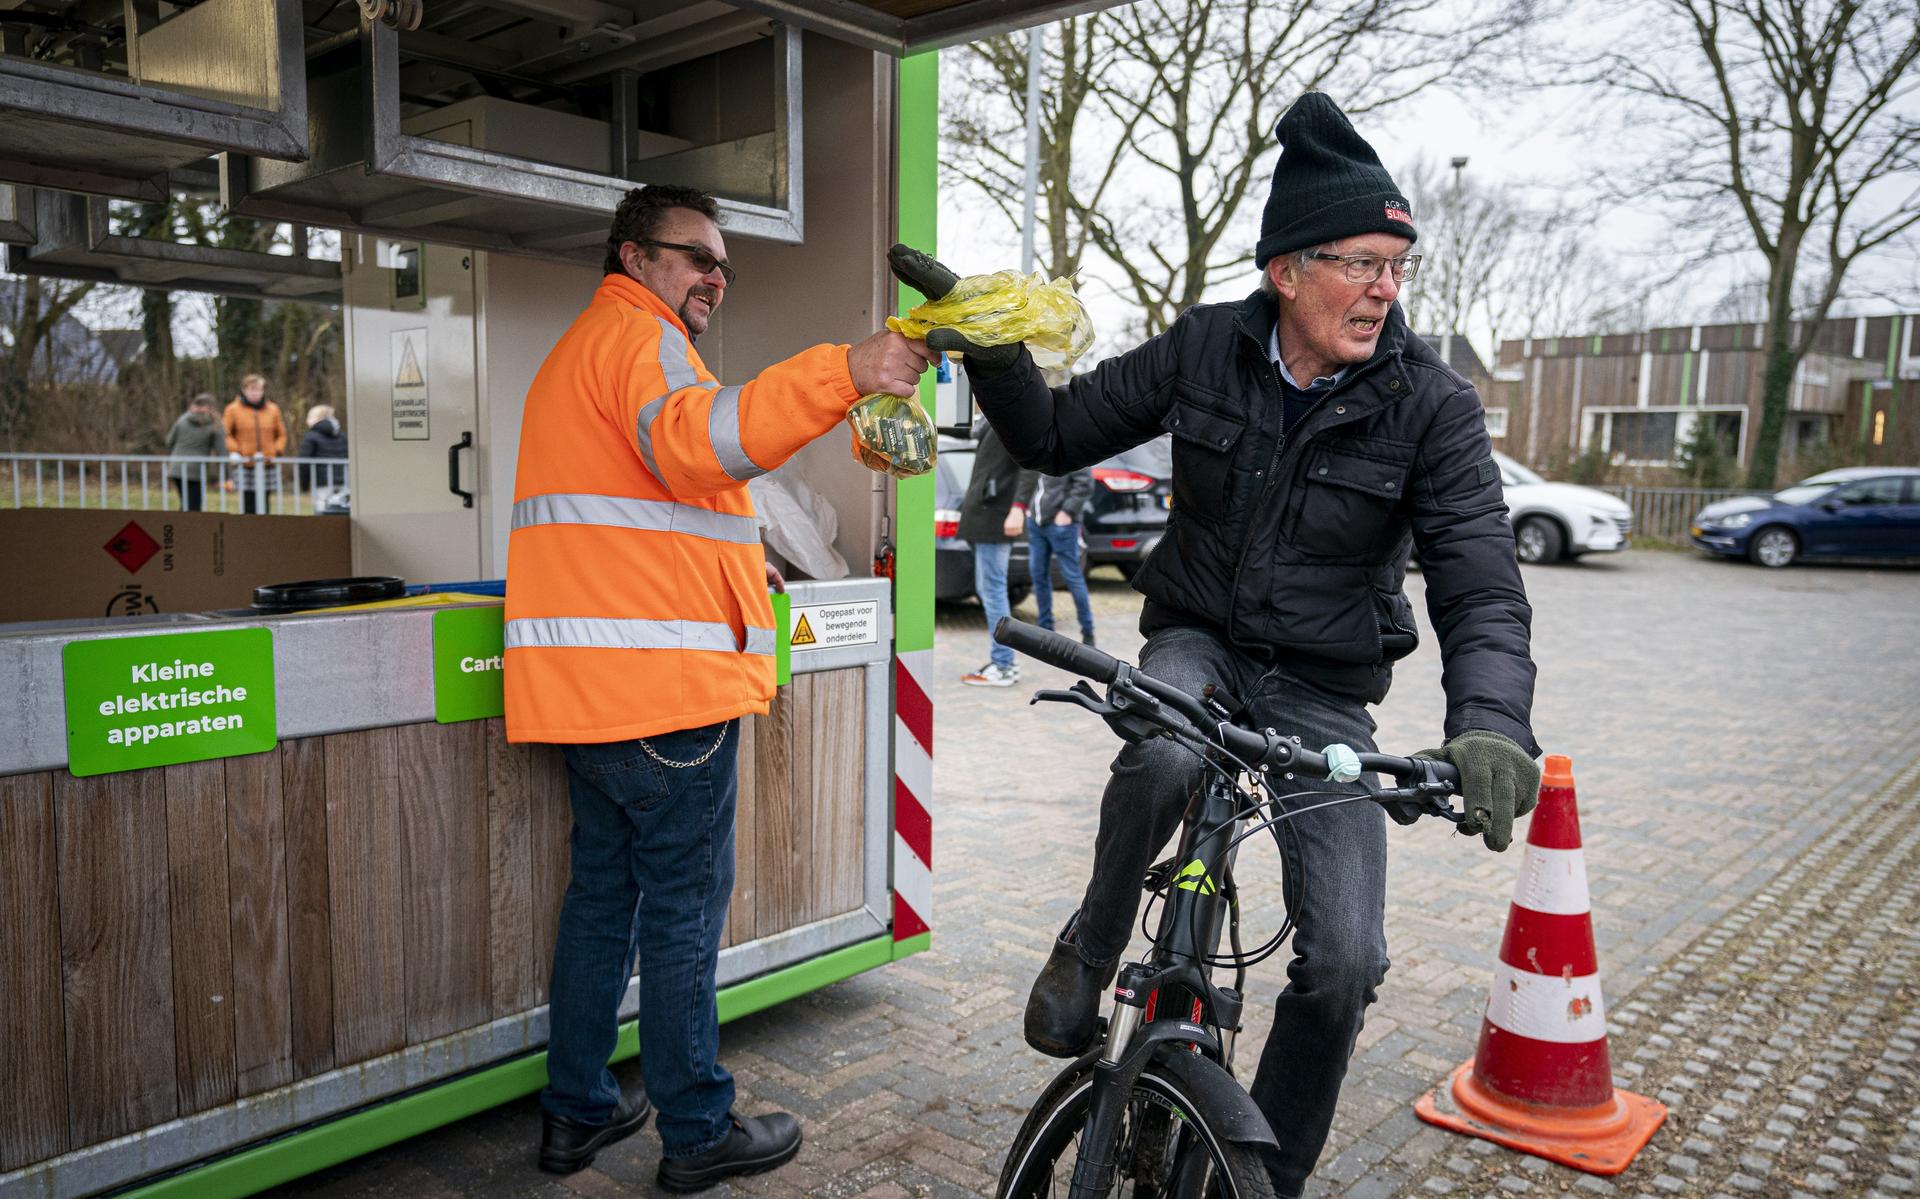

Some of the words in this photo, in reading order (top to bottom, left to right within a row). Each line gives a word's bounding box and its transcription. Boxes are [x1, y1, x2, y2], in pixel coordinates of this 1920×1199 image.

[163, 524, 174, 550] 1950
[163, 554, 174, 571] UN
[820, 608, 855, 619] Opgepast
[826, 620, 867, 630] bewegende
[826, 633, 867, 643] onderdelen
[131, 659, 215, 684] Kleine
[99, 684, 248, 716] elektrische
[107, 714, 243, 747] apparaten
